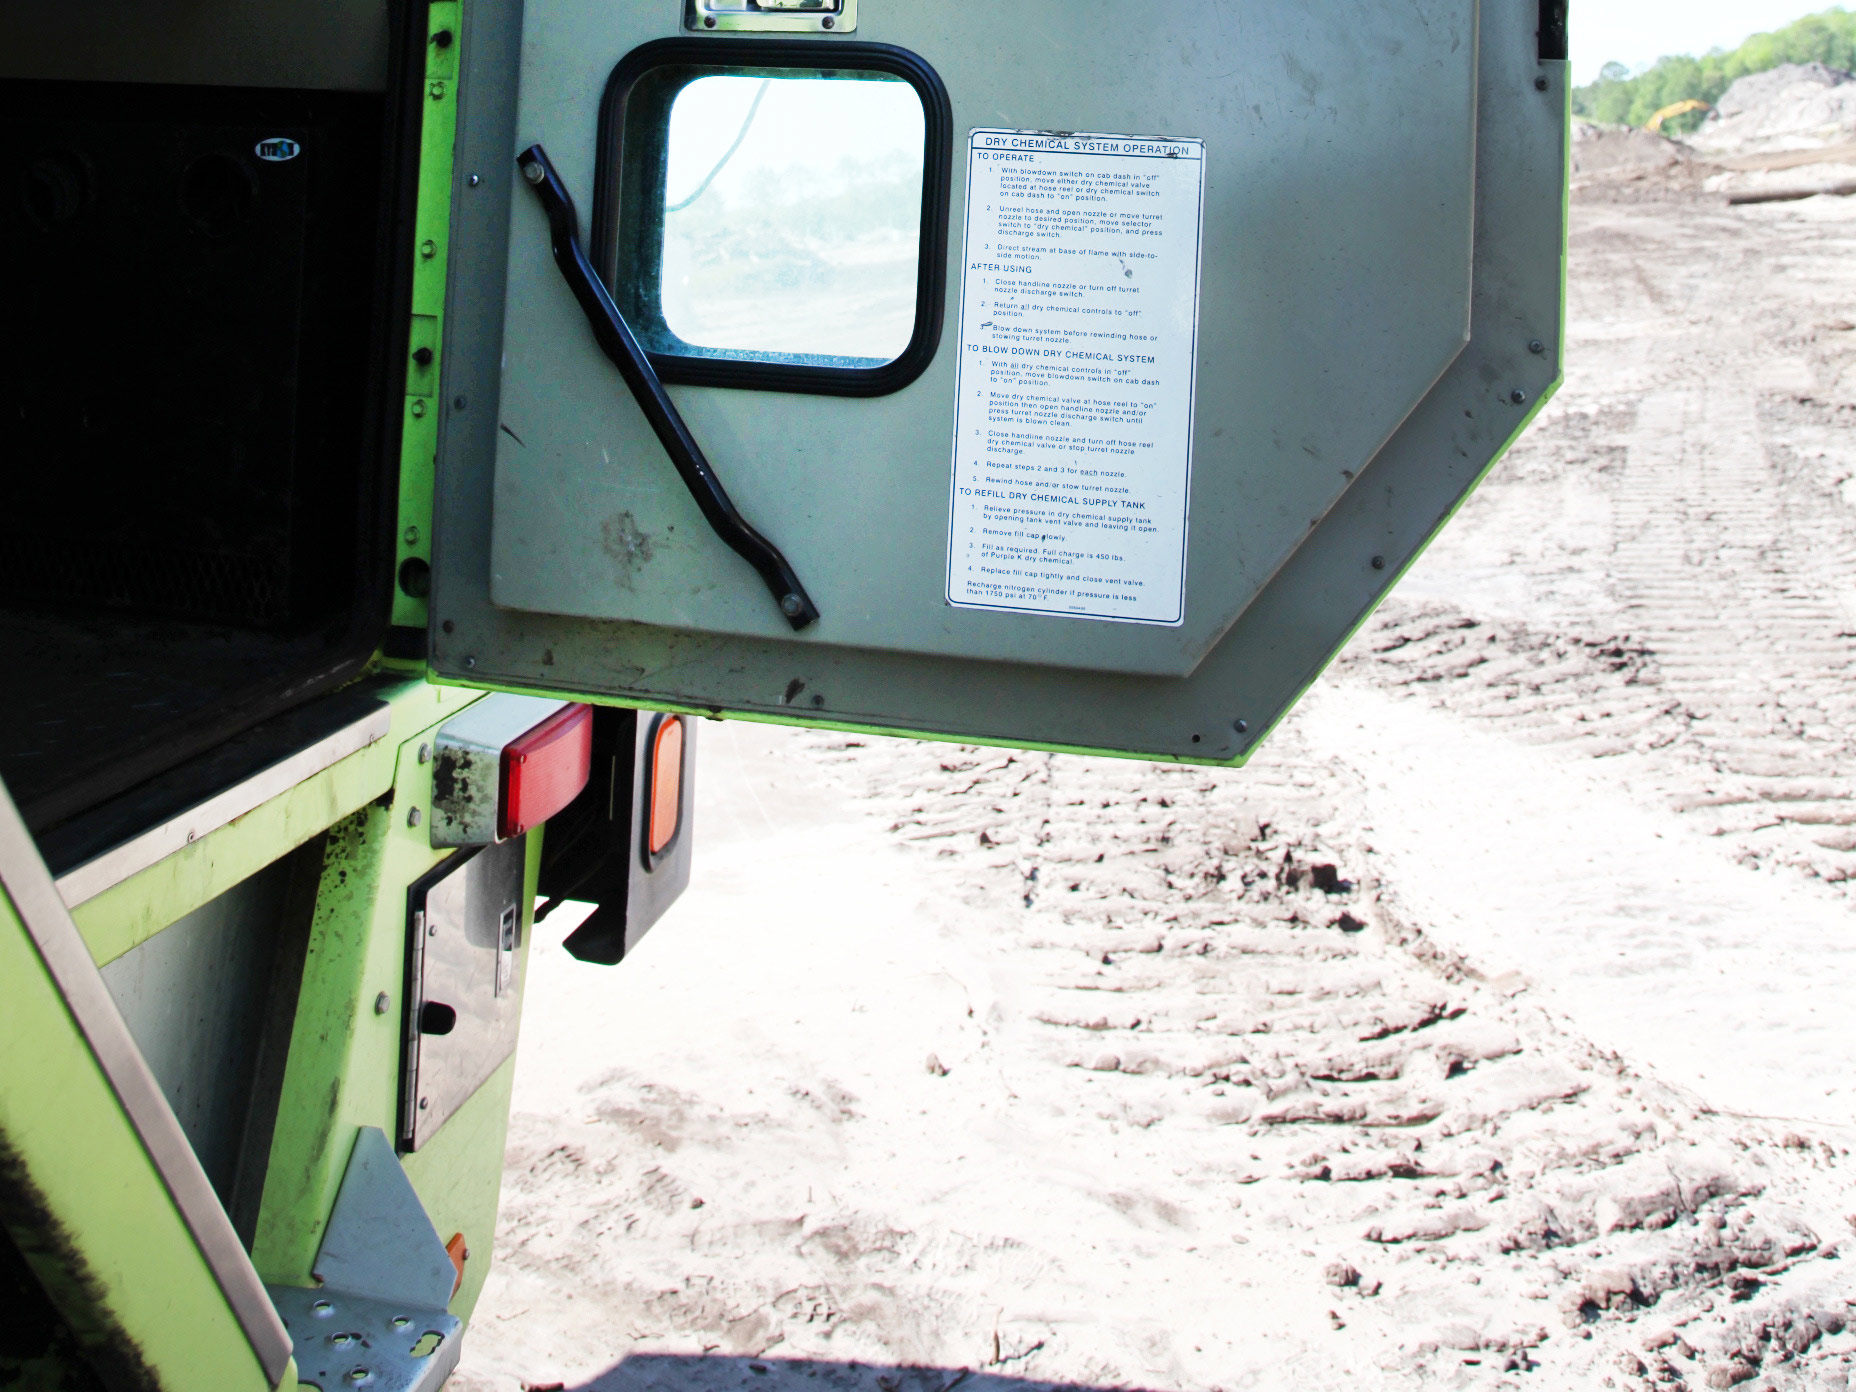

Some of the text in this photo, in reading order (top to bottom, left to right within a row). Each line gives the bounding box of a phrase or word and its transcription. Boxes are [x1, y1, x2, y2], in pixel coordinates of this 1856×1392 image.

[985, 137, 1189, 155] DRY CHEMICAL SYSTEM OPERATION
[977, 152, 1034, 163] TO OPERATE
[1020, 168, 1057, 176] blowdown
[1000, 182, 1027, 190] located
[1085, 187, 1098, 195] dry
[1100, 188, 1134, 196] chemical
[1080, 179, 1093, 187] dry
[1095, 180, 1128, 188] chemical
[970, 263, 1032, 274] AFTER USING
[995, 278, 1016, 286] Close
[1018, 280, 1050, 288] handline
[1020, 288, 1057, 297] discharge
[967, 344, 1155, 364] TO BLOW DOWN DRY CHEMICAL SYSTEM
[959, 487, 1145, 509] TO REFILL DRY CHEMICAL SUPPLY TANK
[980, 566, 1011, 575] Replace
[1040, 572, 1063, 581] tightly
[967, 580, 1002, 591] Recharge
[1004, 585, 1035, 593] nitrogen
[1077, 591, 1110, 599] pressure
[1121, 594, 1137, 602] less
